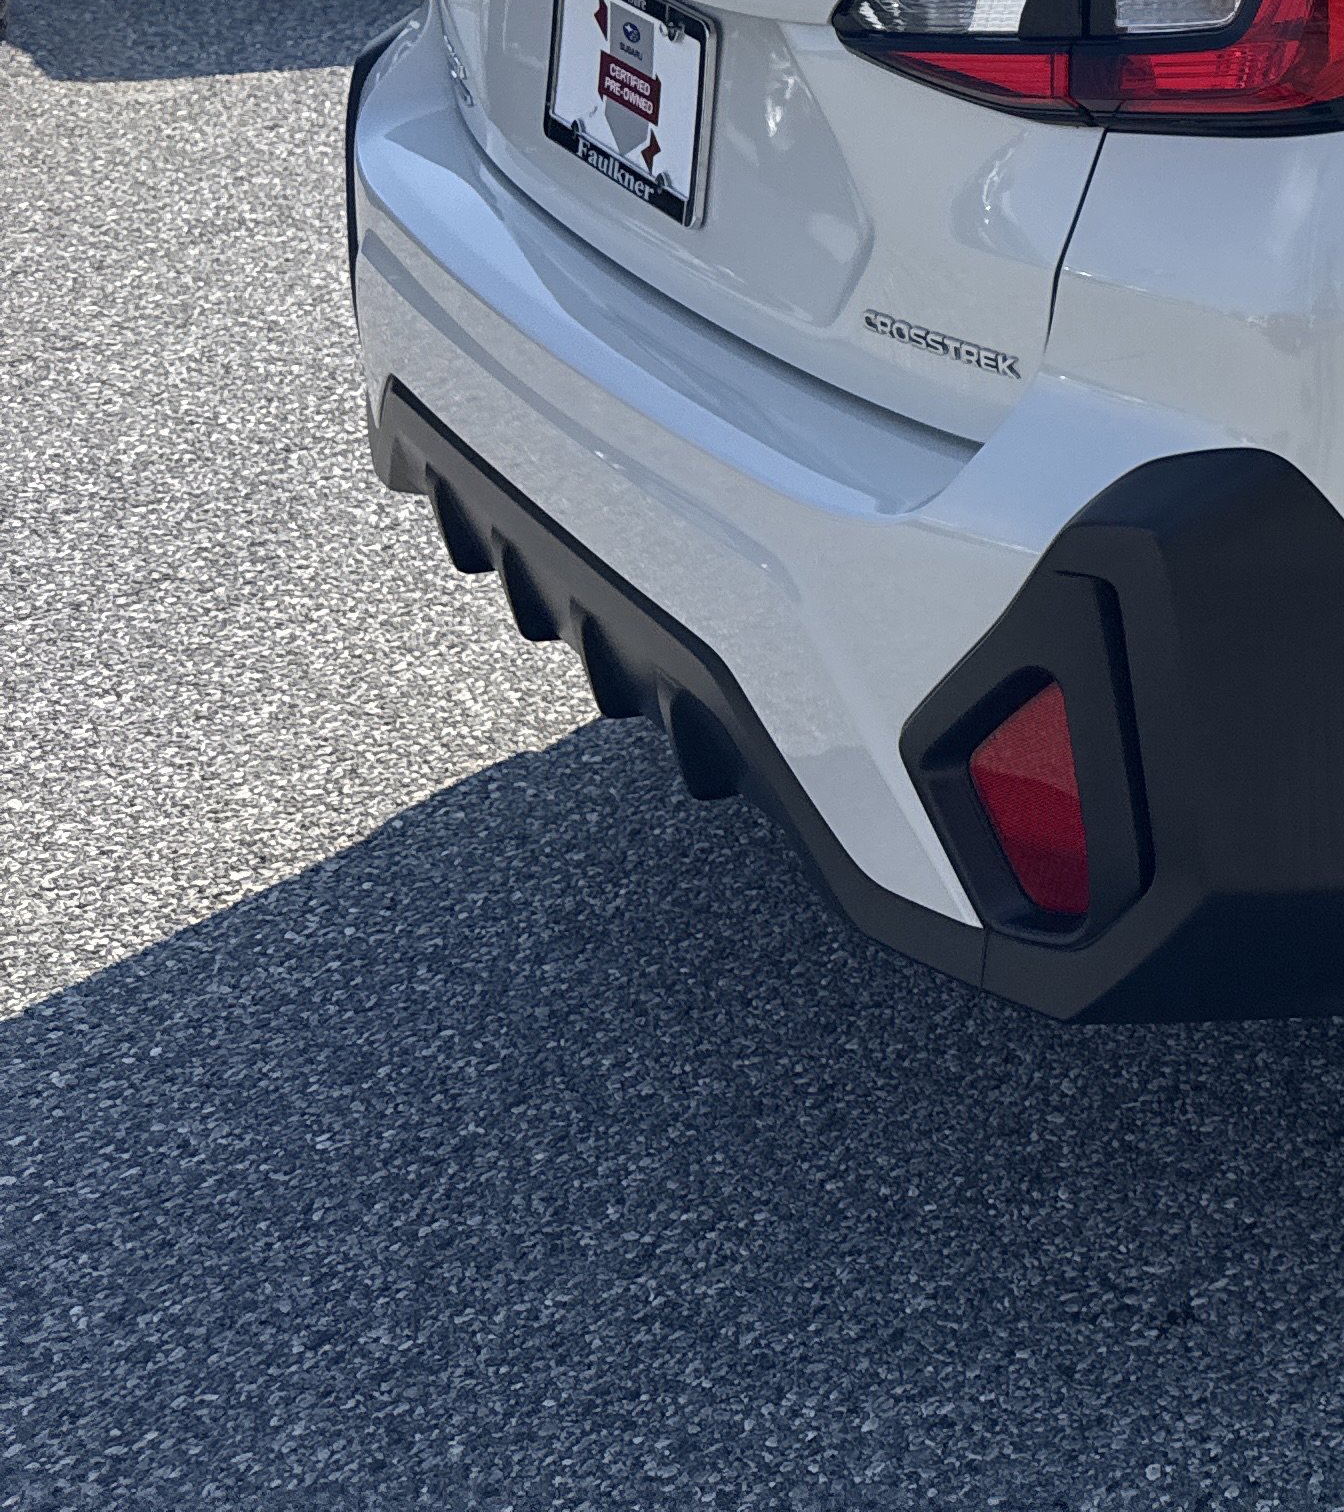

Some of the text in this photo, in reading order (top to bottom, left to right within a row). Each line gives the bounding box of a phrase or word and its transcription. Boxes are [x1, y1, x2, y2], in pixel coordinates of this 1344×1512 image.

[619, 41, 643, 61] SUBARU
[604, 76, 654, 114] PRE-OWNED
[609, 63, 651, 96] CERTIFIED
[576, 138, 655, 201] Faulkner
[863, 309, 1021, 379] CROSSTREK
